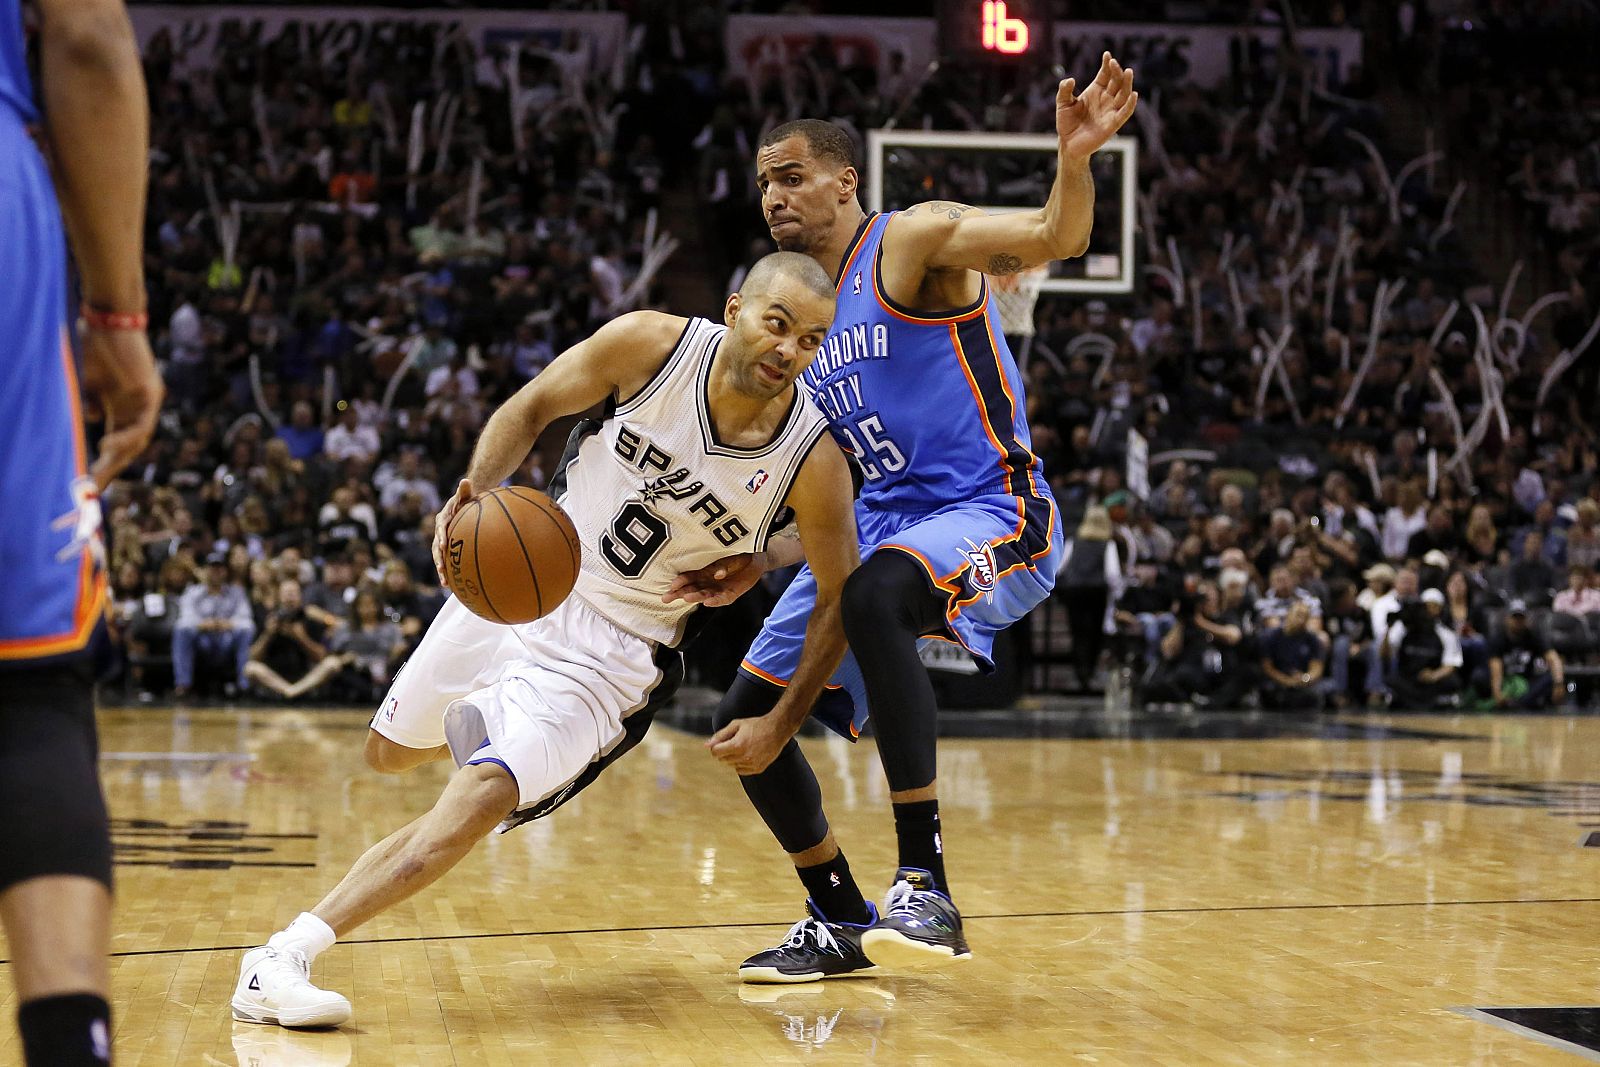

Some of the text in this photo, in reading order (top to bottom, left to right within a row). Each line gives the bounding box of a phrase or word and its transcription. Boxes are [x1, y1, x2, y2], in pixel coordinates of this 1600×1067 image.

[982, 0, 1029, 53] 16
[817, 373, 865, 421] CITY
[842, 411, 910, 482] 25
[614, 424, 750, 548] SPURS
[599, 500, 672, 579] 9
